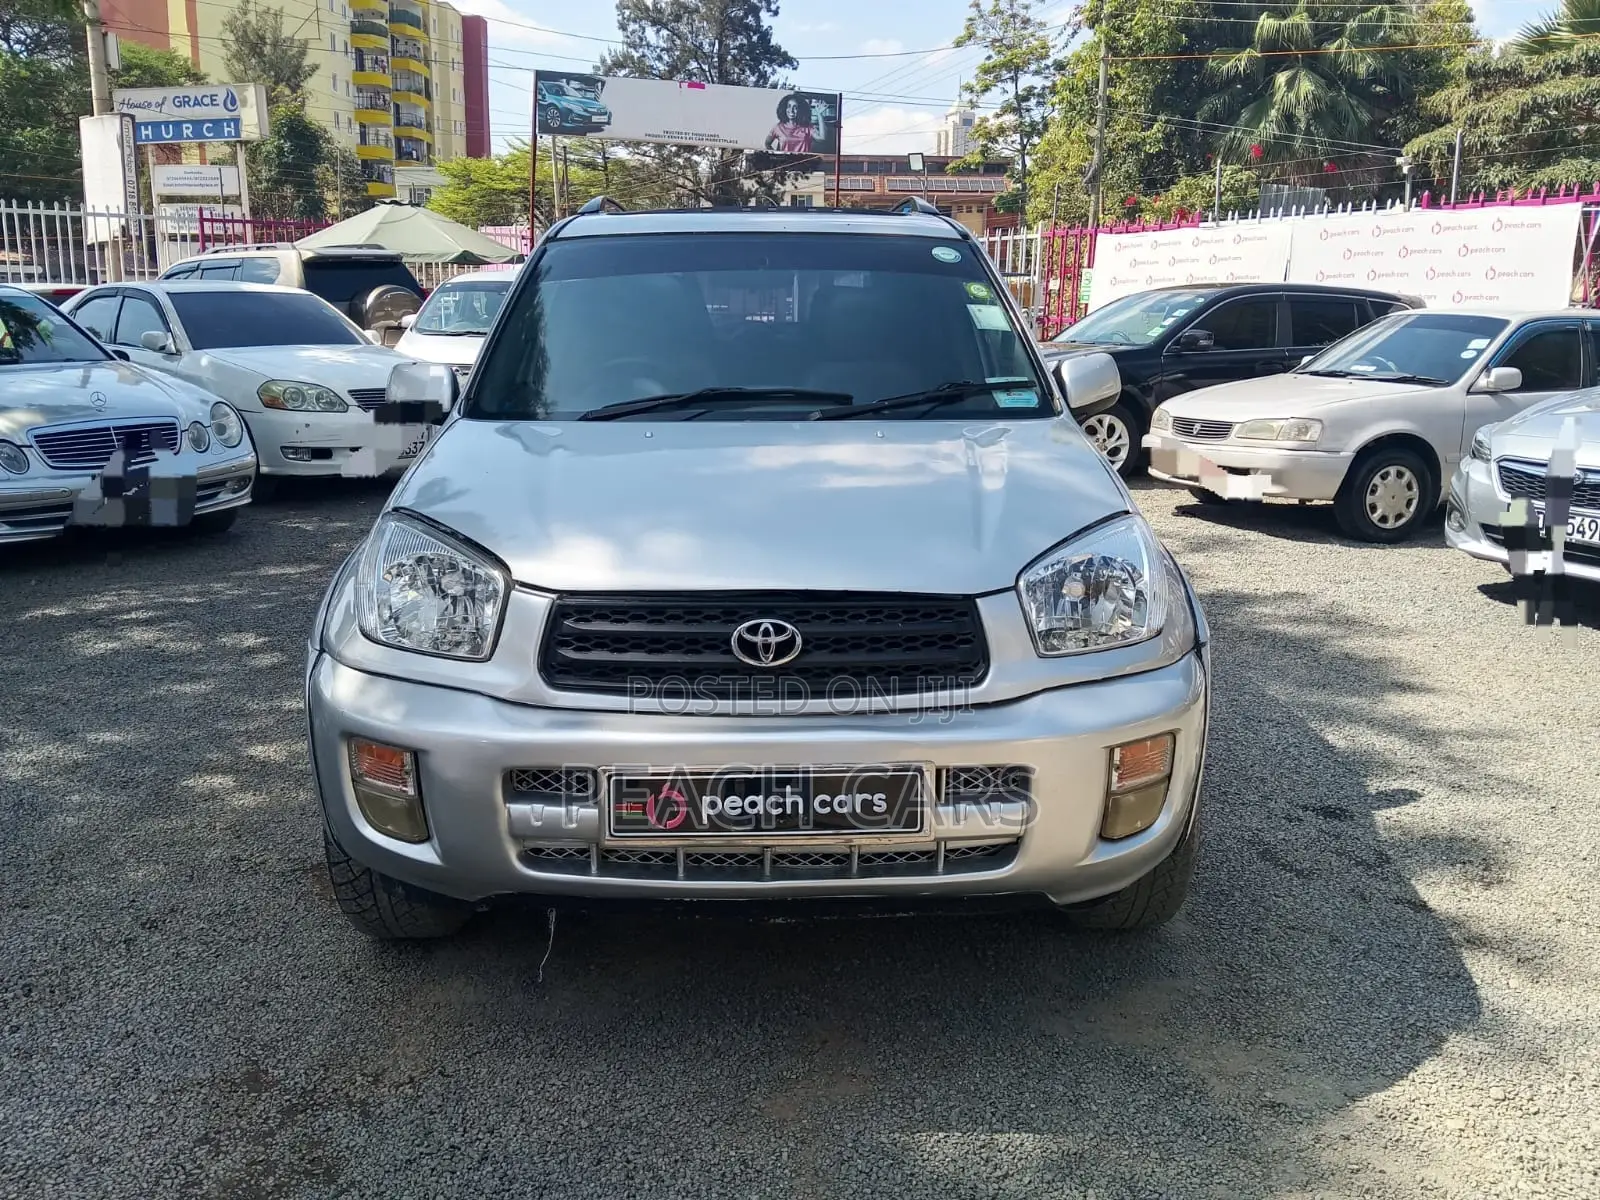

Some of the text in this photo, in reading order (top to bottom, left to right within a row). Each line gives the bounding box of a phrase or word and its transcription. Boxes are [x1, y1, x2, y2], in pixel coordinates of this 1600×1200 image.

[119, 94, 219, 113] House of GRACE
[141, 121, 235, 140] HURCH
[702, 785, 888, 824] peach cars
